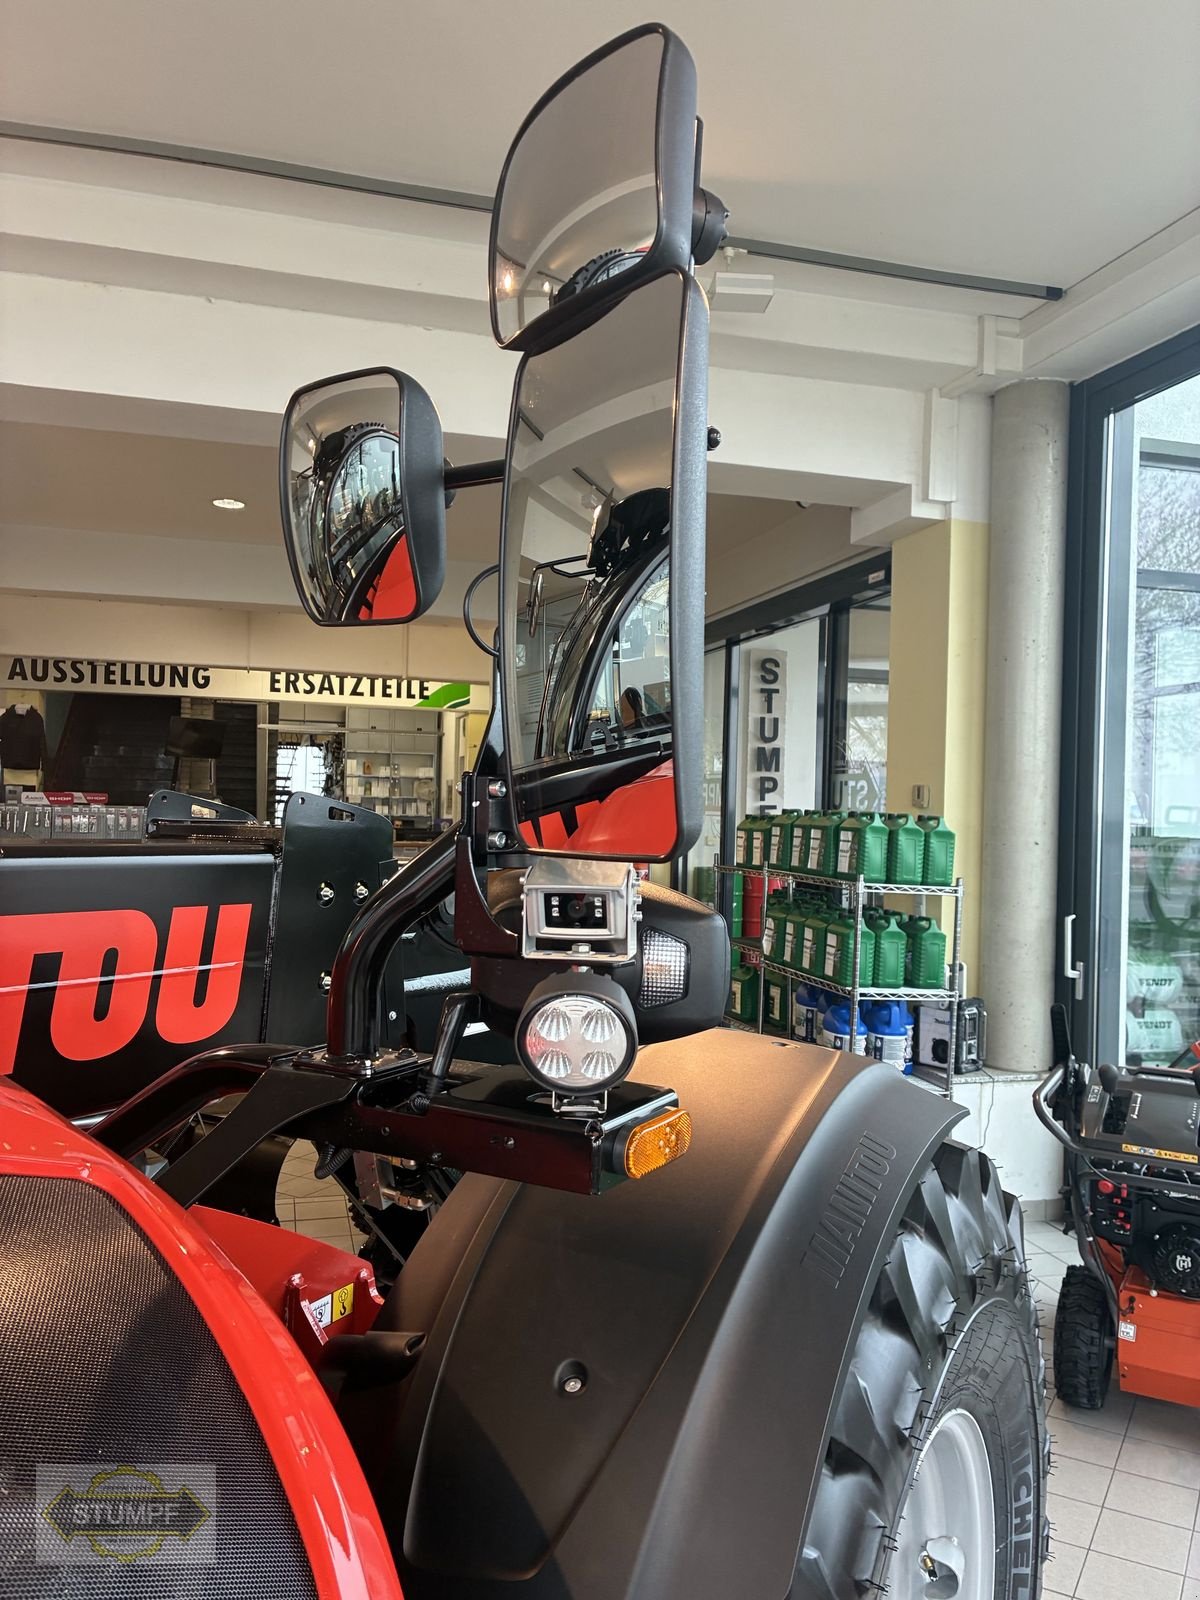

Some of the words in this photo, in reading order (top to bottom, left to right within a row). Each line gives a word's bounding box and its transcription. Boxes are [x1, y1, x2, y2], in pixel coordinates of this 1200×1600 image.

[7, 657, 211, 689] AUSSTELLUNG
[269, 671, 431, 700] ERSATZTEILE
[1138, 978, 1175, 987] FENDT
[1136, 1020, 1173, 1030] FENDT
[800, 1130, 897, 1289] MANITOU
